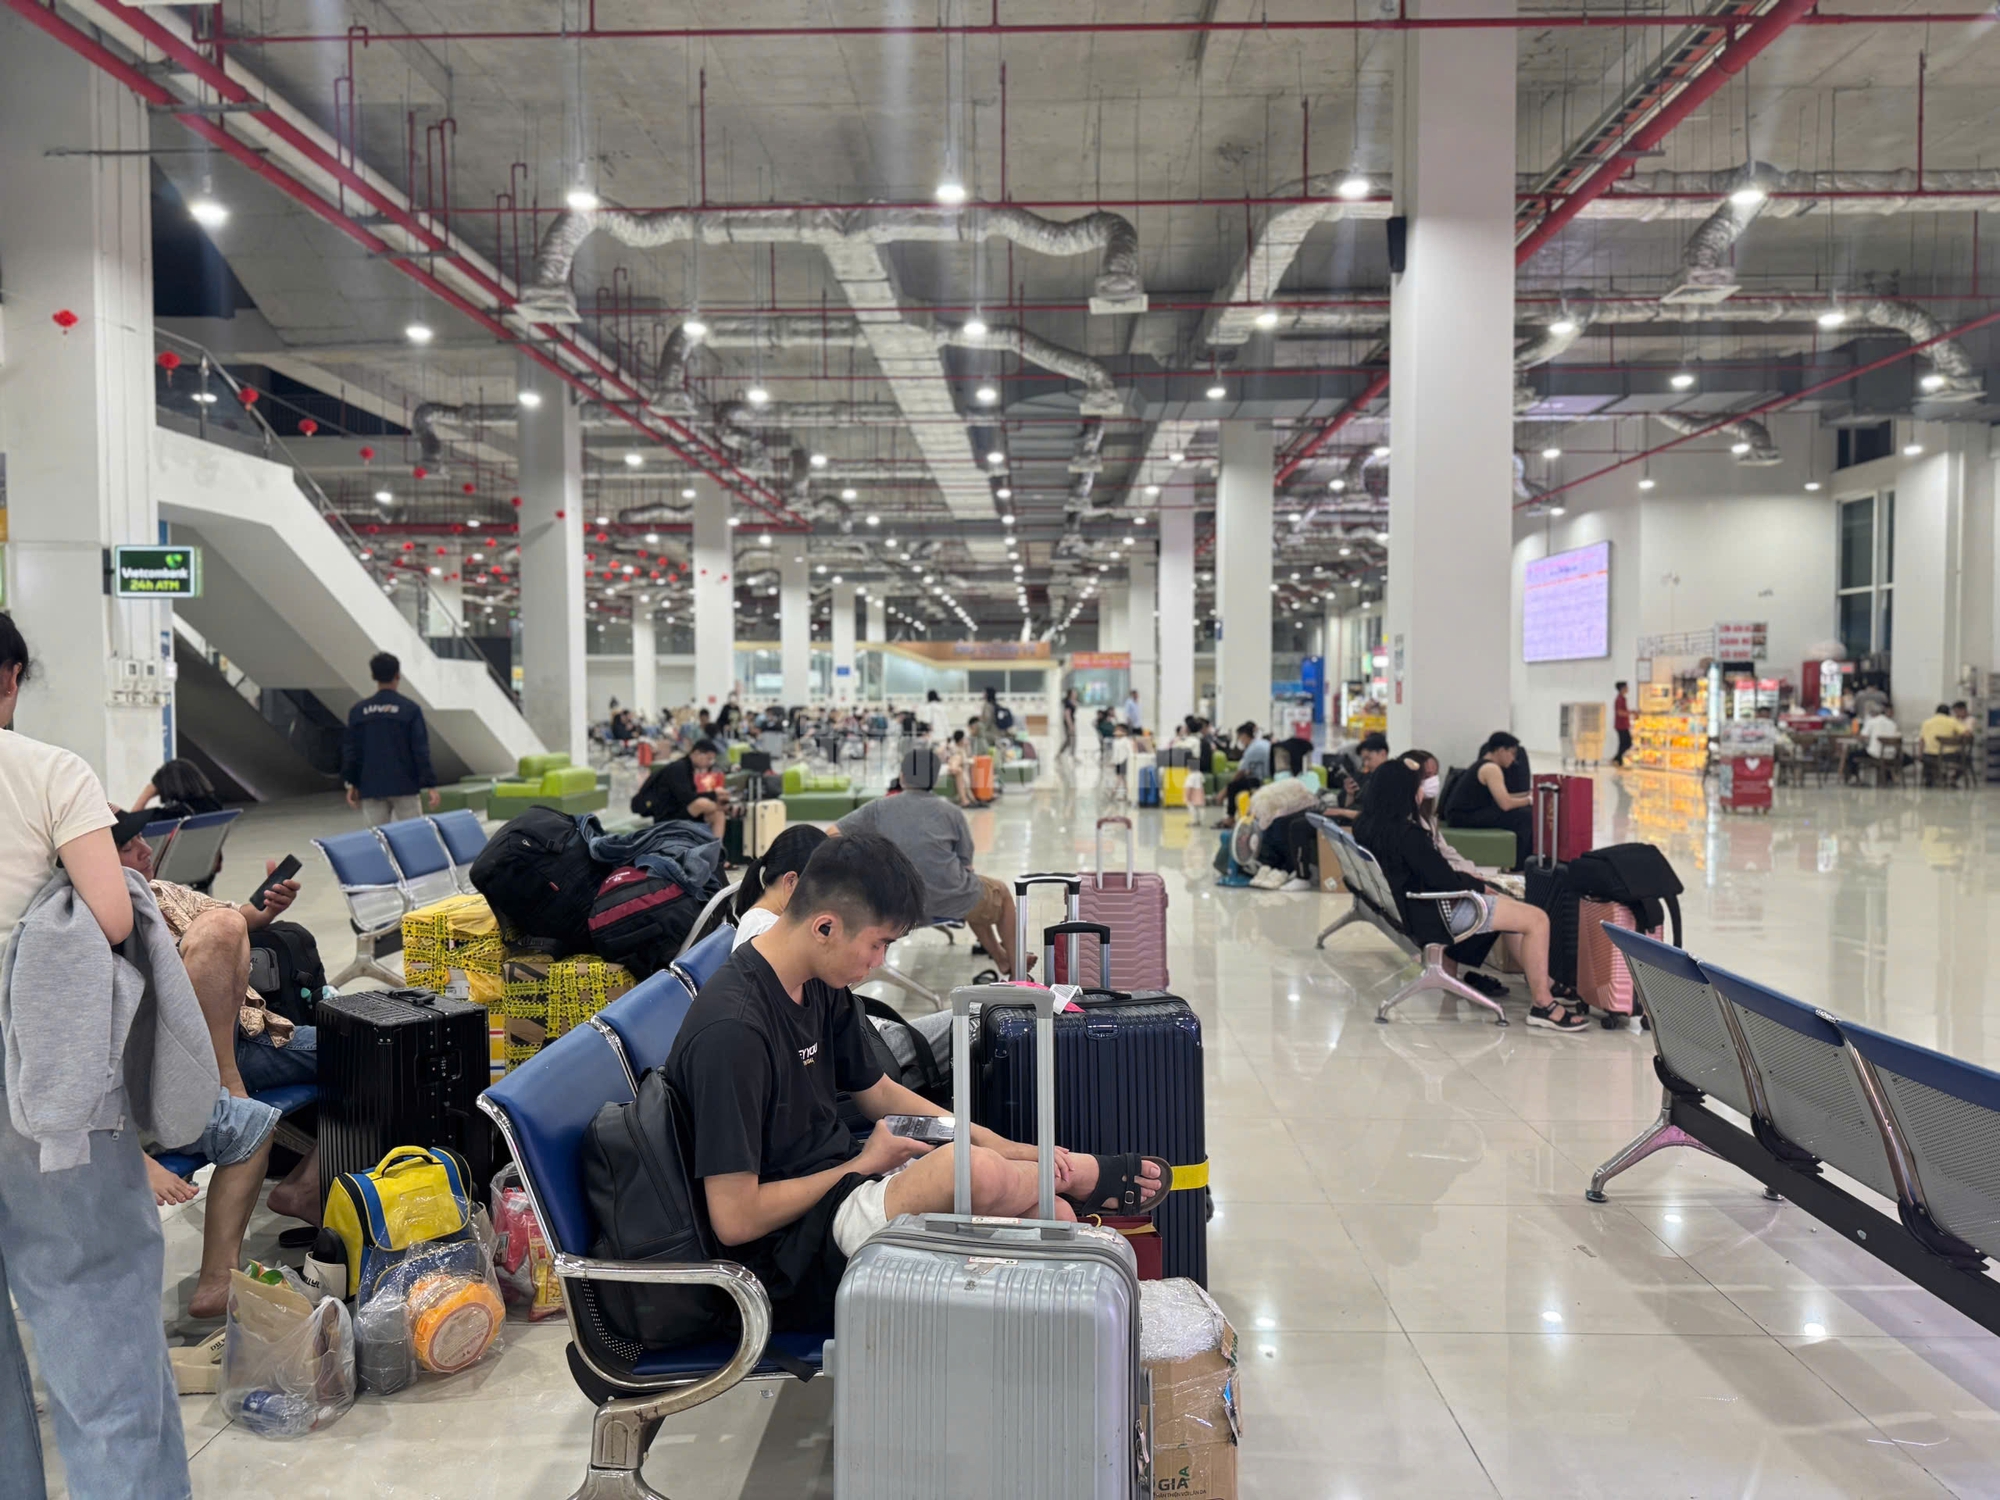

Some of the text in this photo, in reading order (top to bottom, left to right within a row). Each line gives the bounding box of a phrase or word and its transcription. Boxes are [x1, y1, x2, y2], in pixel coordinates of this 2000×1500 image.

[121, 567, 188, 579] Vietcombank
[130, 579, 180, 591] 24h ATM
